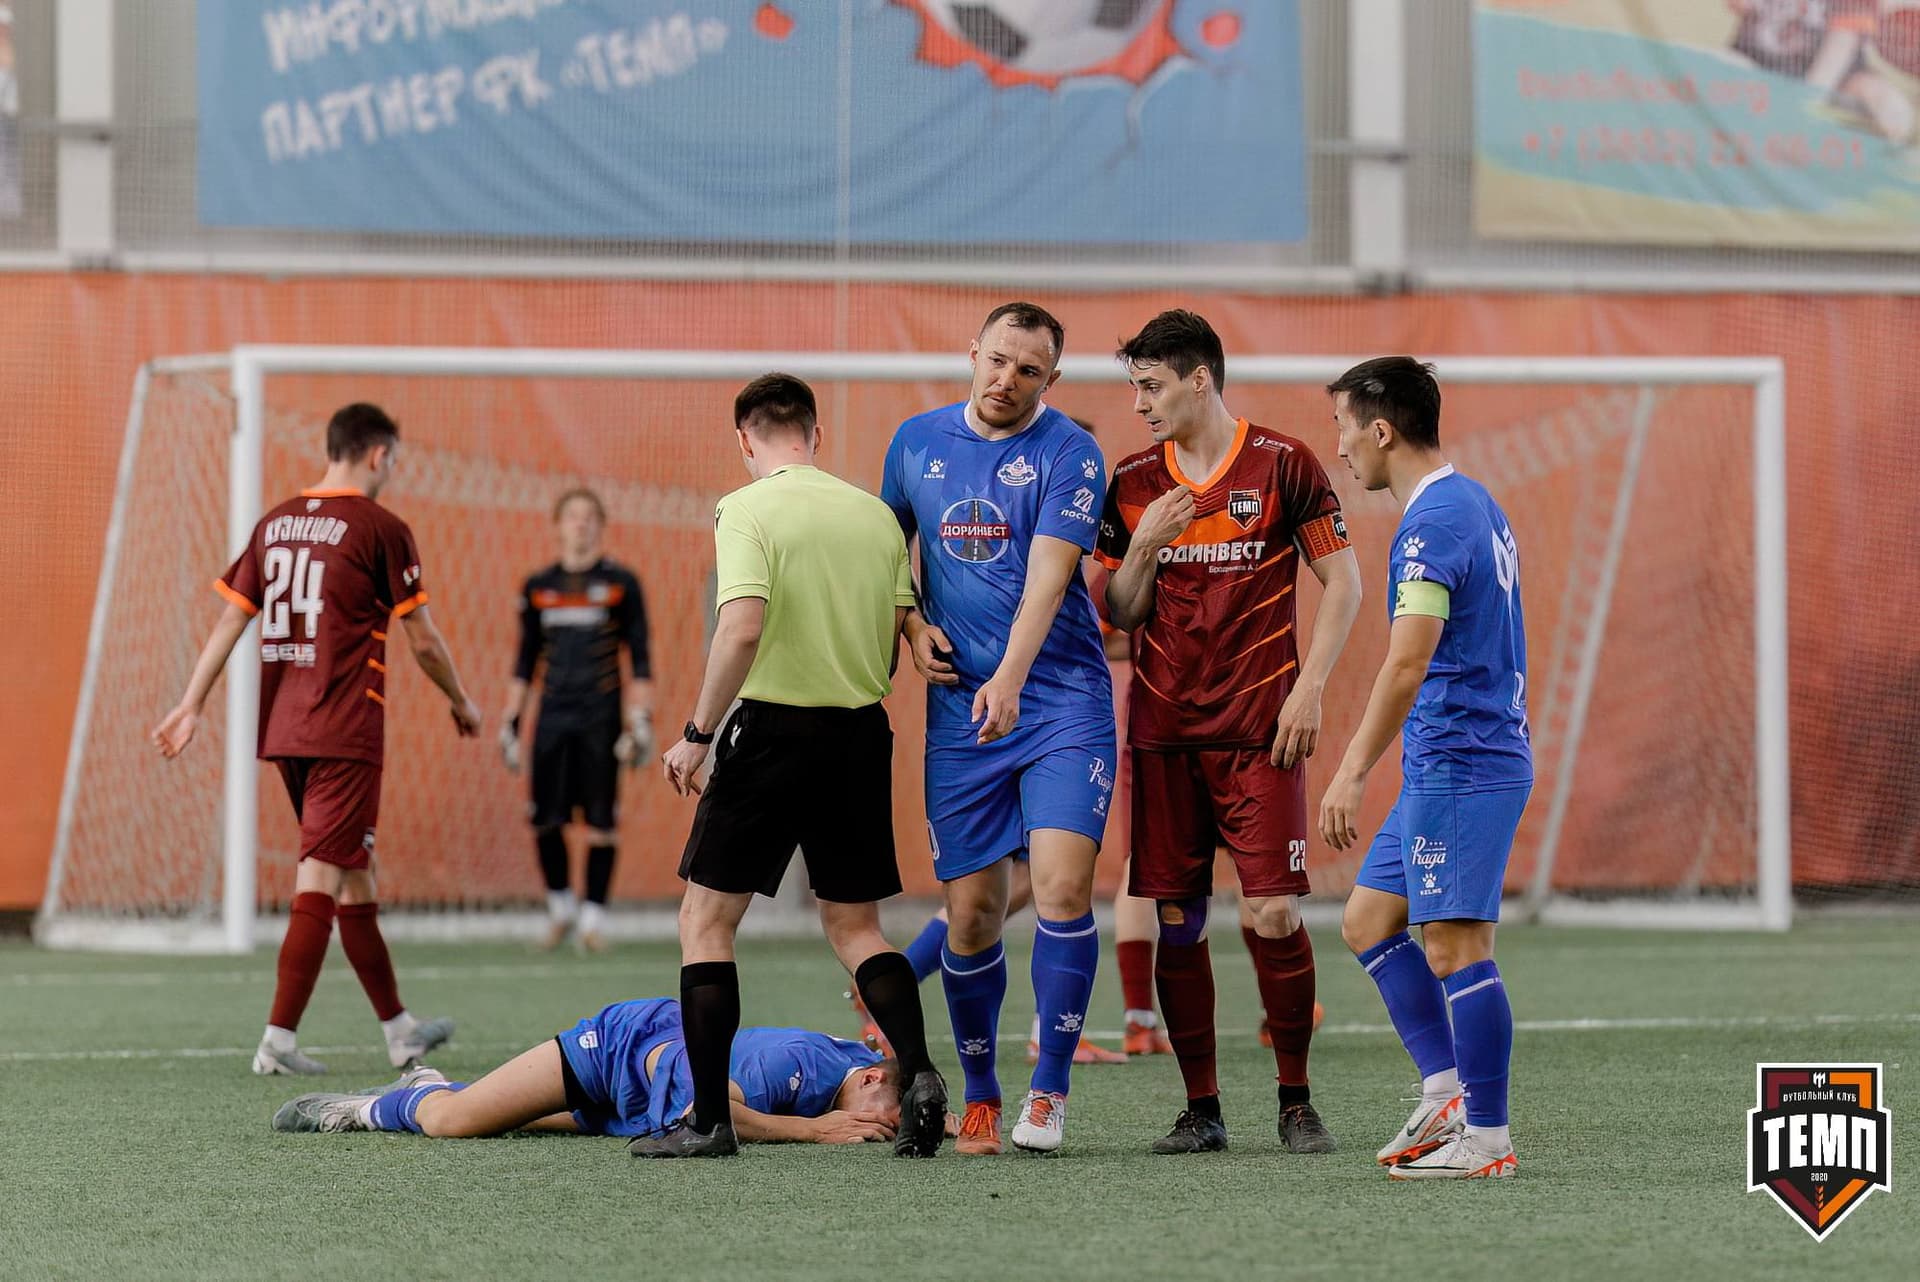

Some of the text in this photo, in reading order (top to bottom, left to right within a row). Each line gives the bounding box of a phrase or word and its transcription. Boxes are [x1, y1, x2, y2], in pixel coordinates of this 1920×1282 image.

[261, 67, 465, 163] ПАРТНЕР
[471, 50, 553, 116] ФК
[1231, 500, 1258, 515] ТЕМП
[262, 547, 325, 639] 24
